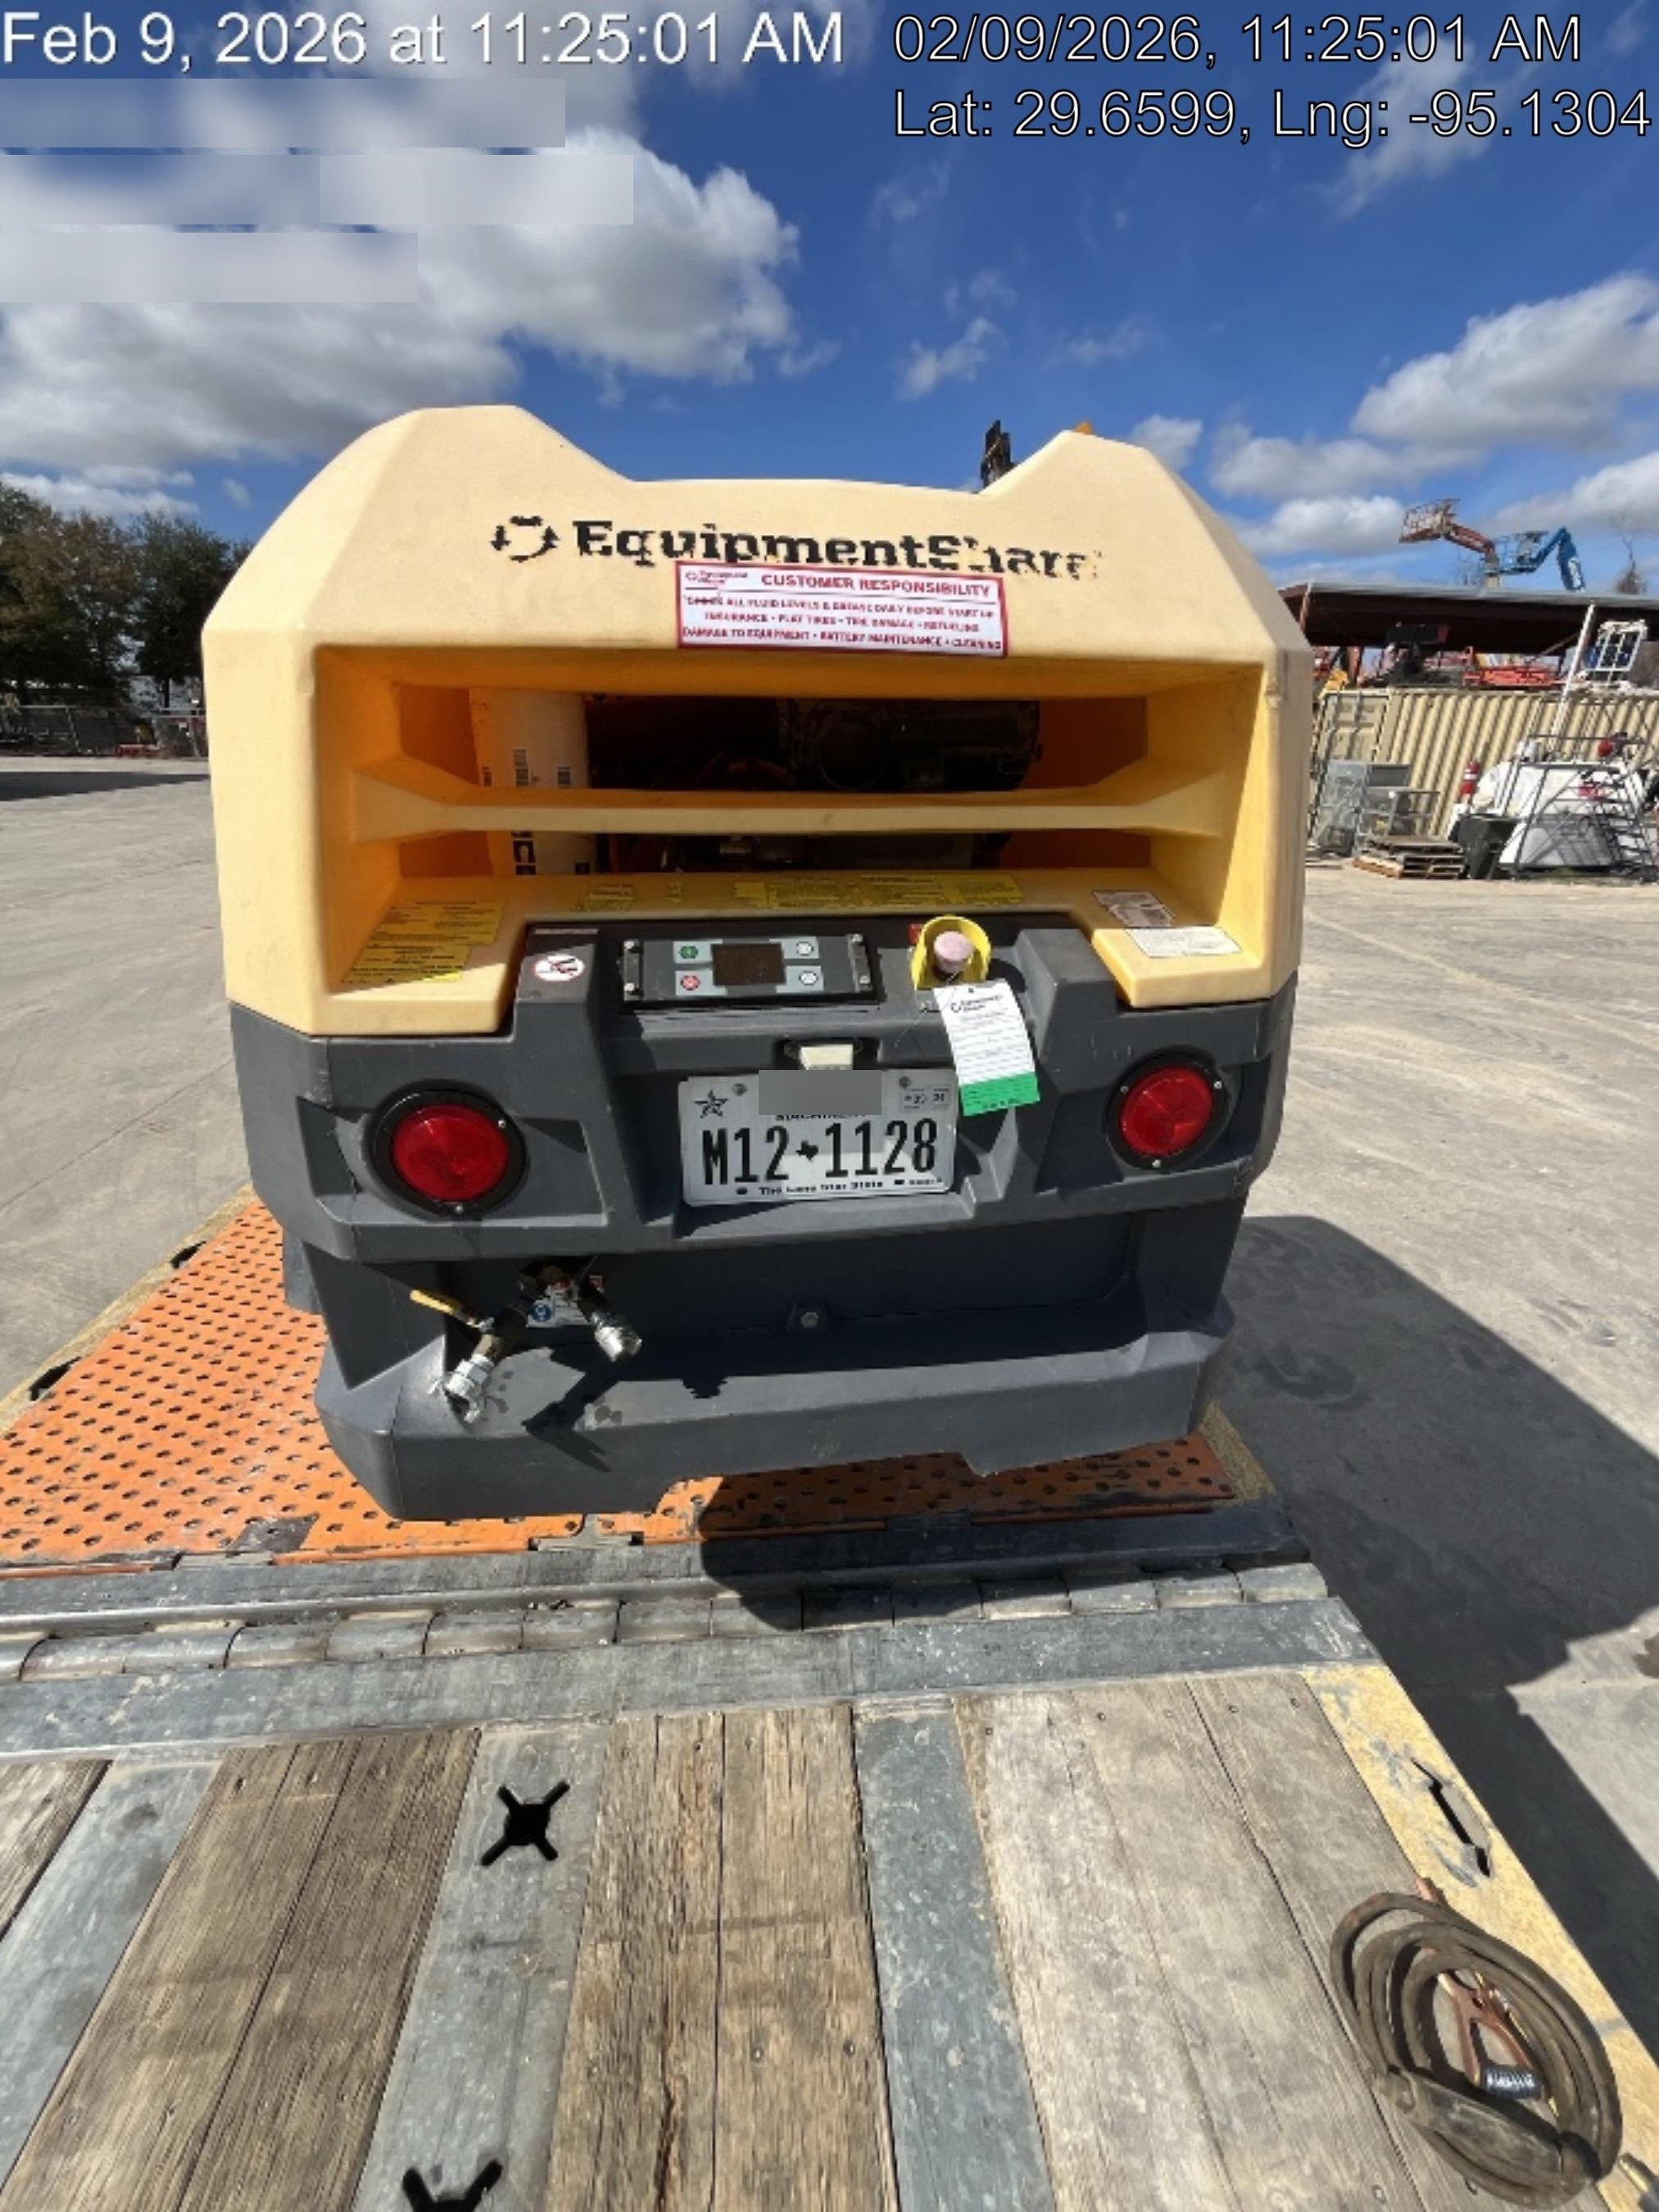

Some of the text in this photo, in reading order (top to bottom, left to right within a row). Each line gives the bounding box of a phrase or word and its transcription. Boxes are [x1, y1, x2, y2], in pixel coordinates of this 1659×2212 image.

[761, 574, 854, 590] CUSTOMER
[859, 578, 990, 597] RESPONSIBILITY
[731, 628, 746, 637] TO
[701, 1117, 939, 1185] M12 1128
